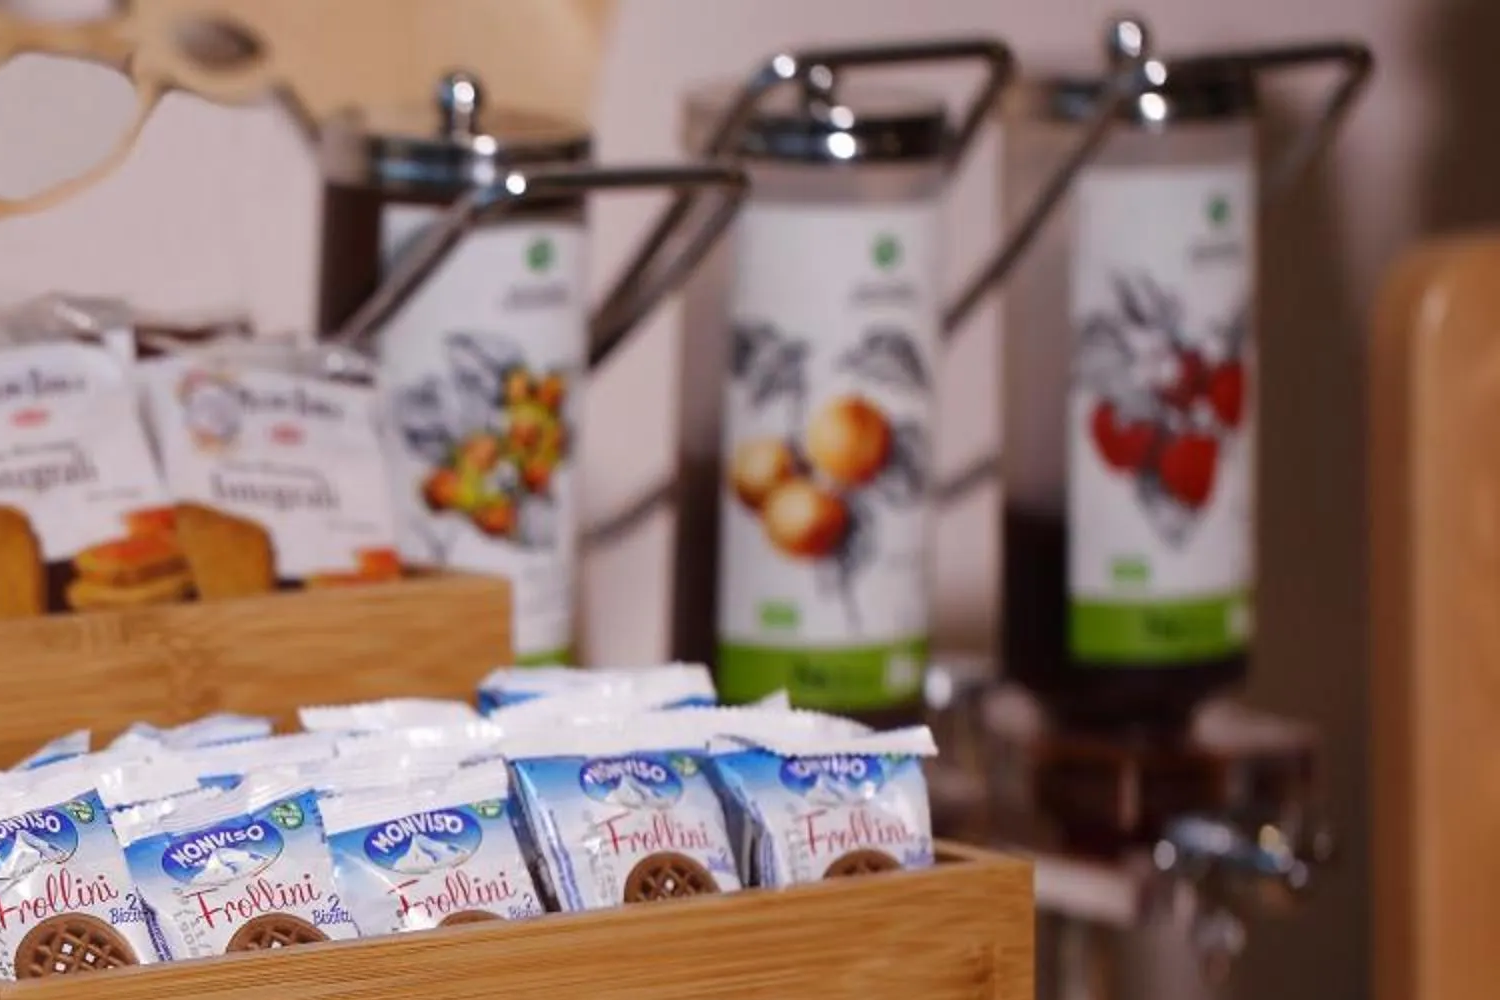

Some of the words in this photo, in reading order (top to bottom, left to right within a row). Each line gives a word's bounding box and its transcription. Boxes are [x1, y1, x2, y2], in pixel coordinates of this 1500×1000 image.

[171, 825, 265, 869] MONVISO
[372, 812, 464, 853] MONVISO
[597, 809, 715, 855] Frollini
[183, 873, 323, 930] Frollini
[387, 868, 518, 918] Frollini
